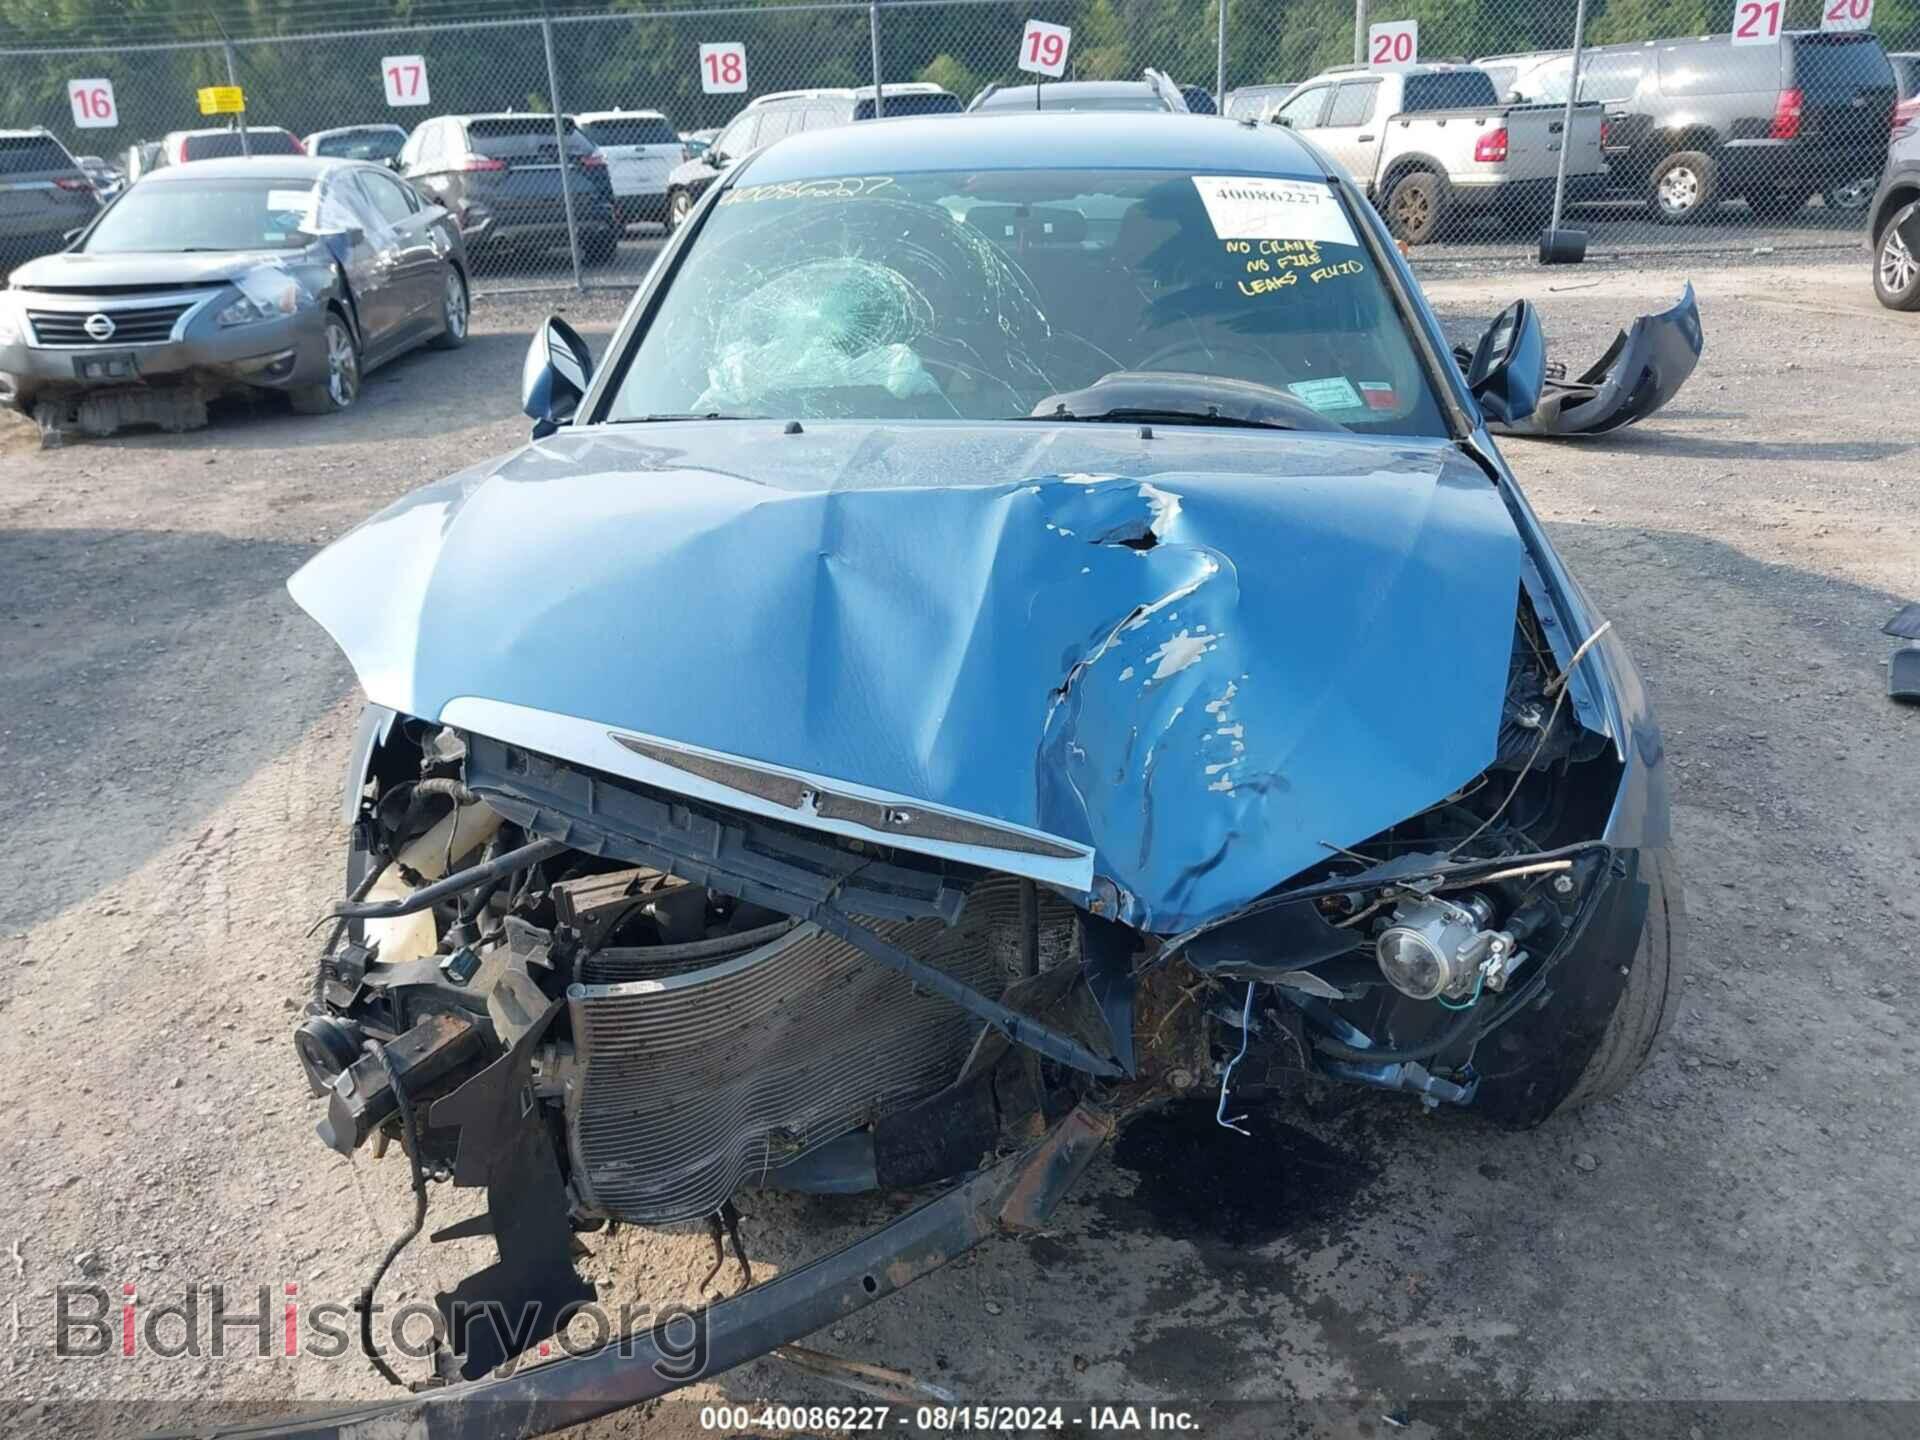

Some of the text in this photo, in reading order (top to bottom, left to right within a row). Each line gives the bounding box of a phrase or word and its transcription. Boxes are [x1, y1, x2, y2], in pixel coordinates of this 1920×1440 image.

[1736, 1, 1780, 38] 21
[1826, 0, 1870, 21] 20
[1027, 30, 1065, 67] 19
[1373, 32, 1413, 64] 20
[388, 66, 421, 97] 17
[704, 52, 743, 85] 18
[74, 88, 111, 119] 16
[1216, 188, 1321, 205] 40086227
[1226, 241, 1250, 253] NO
[1237, 259, 1364, 296] LEAKS FLUID
[1246, 259, 1270, 273] NO
